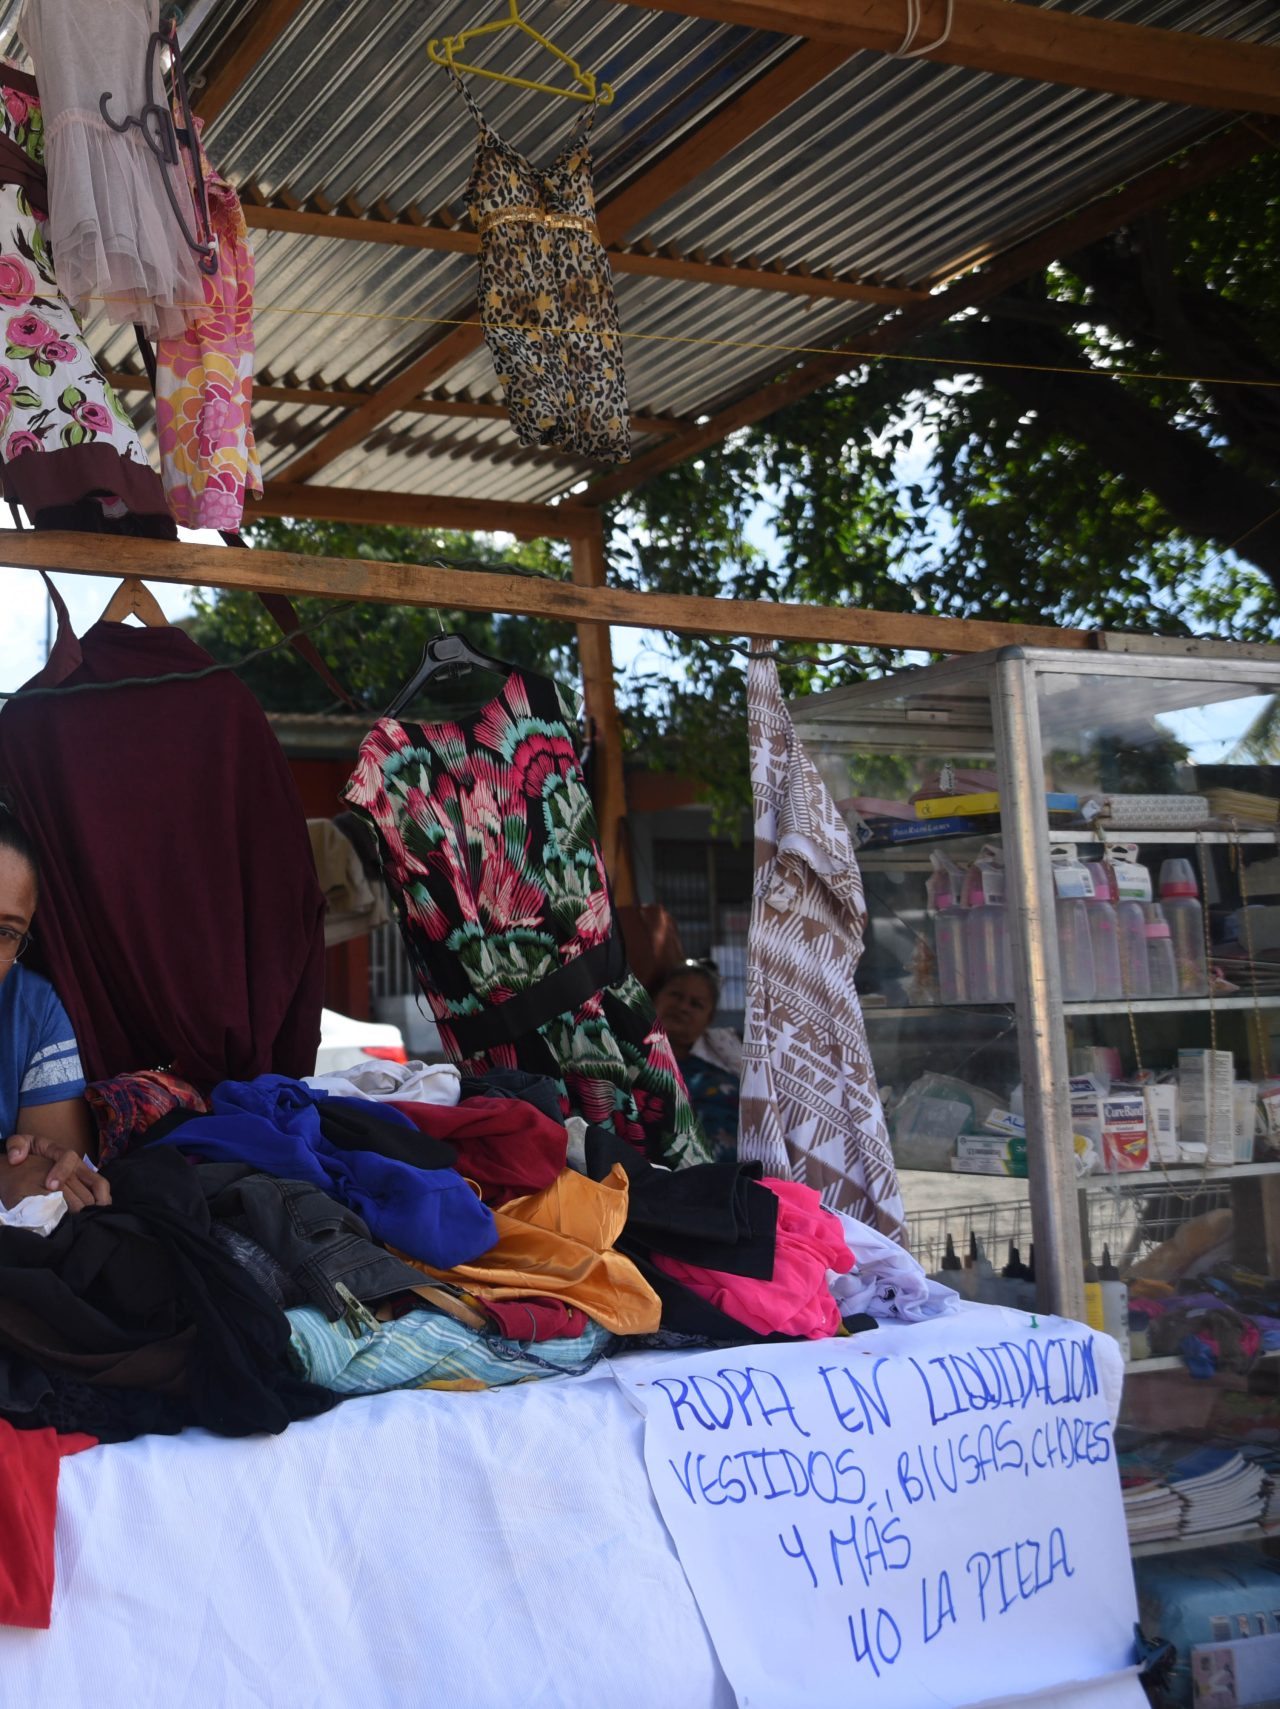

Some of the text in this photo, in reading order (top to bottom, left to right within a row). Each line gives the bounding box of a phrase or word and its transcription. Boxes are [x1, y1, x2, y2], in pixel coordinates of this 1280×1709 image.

[652, 1334, 1099, 1438] ROPA EN LIQUIDACION
[830, 1501, 912, 1588] MÁS
[848, 1526, 1075, 1678] 40 LA PIEZA
